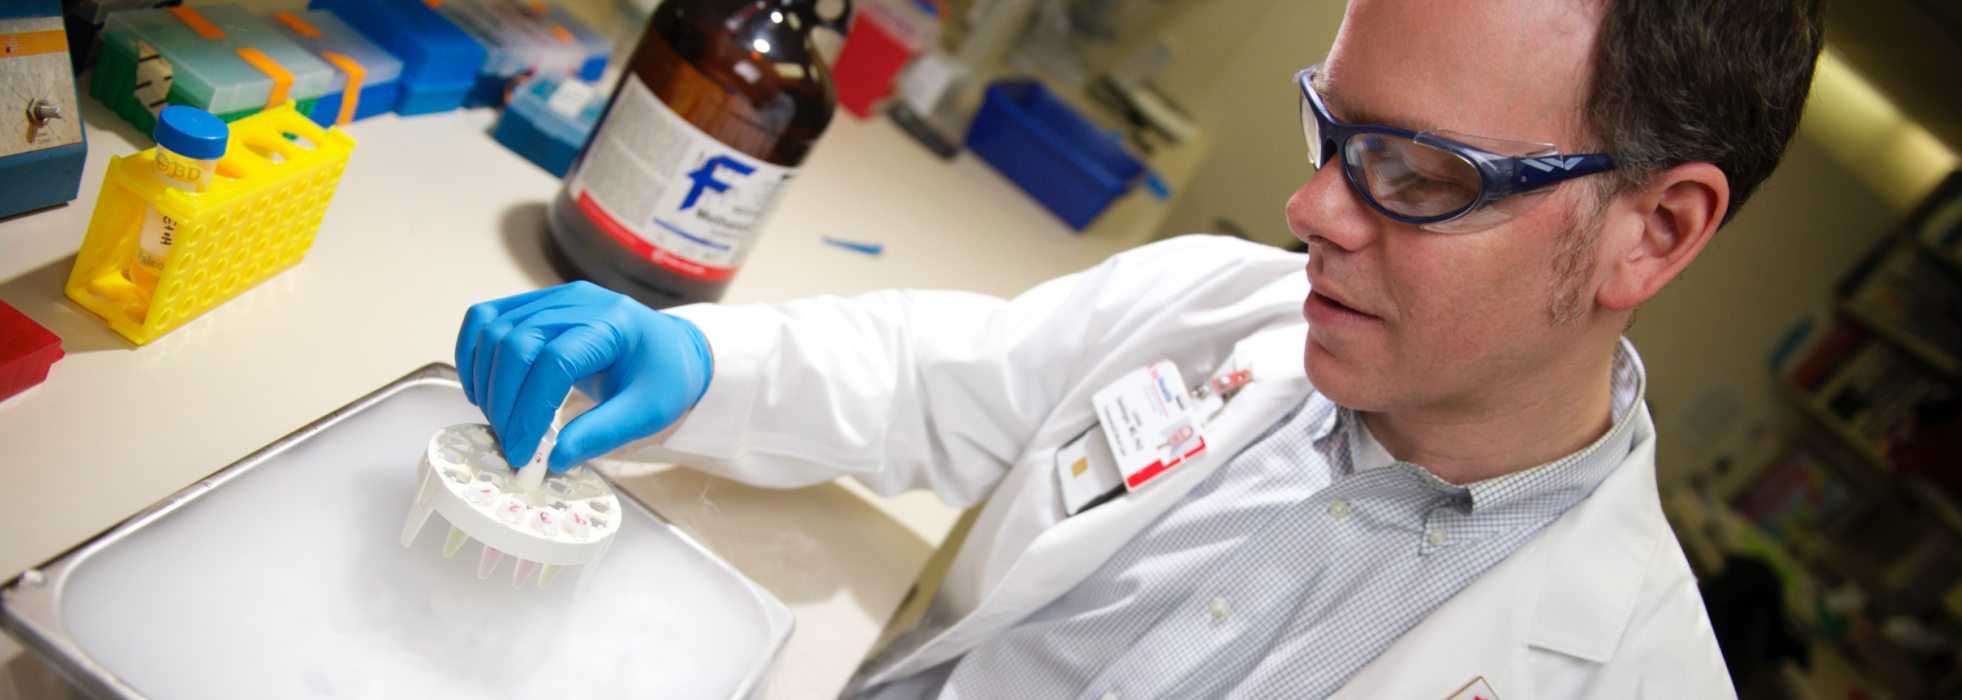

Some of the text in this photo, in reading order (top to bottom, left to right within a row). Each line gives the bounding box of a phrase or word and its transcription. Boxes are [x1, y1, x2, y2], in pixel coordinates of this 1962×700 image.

[171, 162, 201, 180] BD
[679, 155, 757, 211] F
[138, 251, 165, 270] Falco
